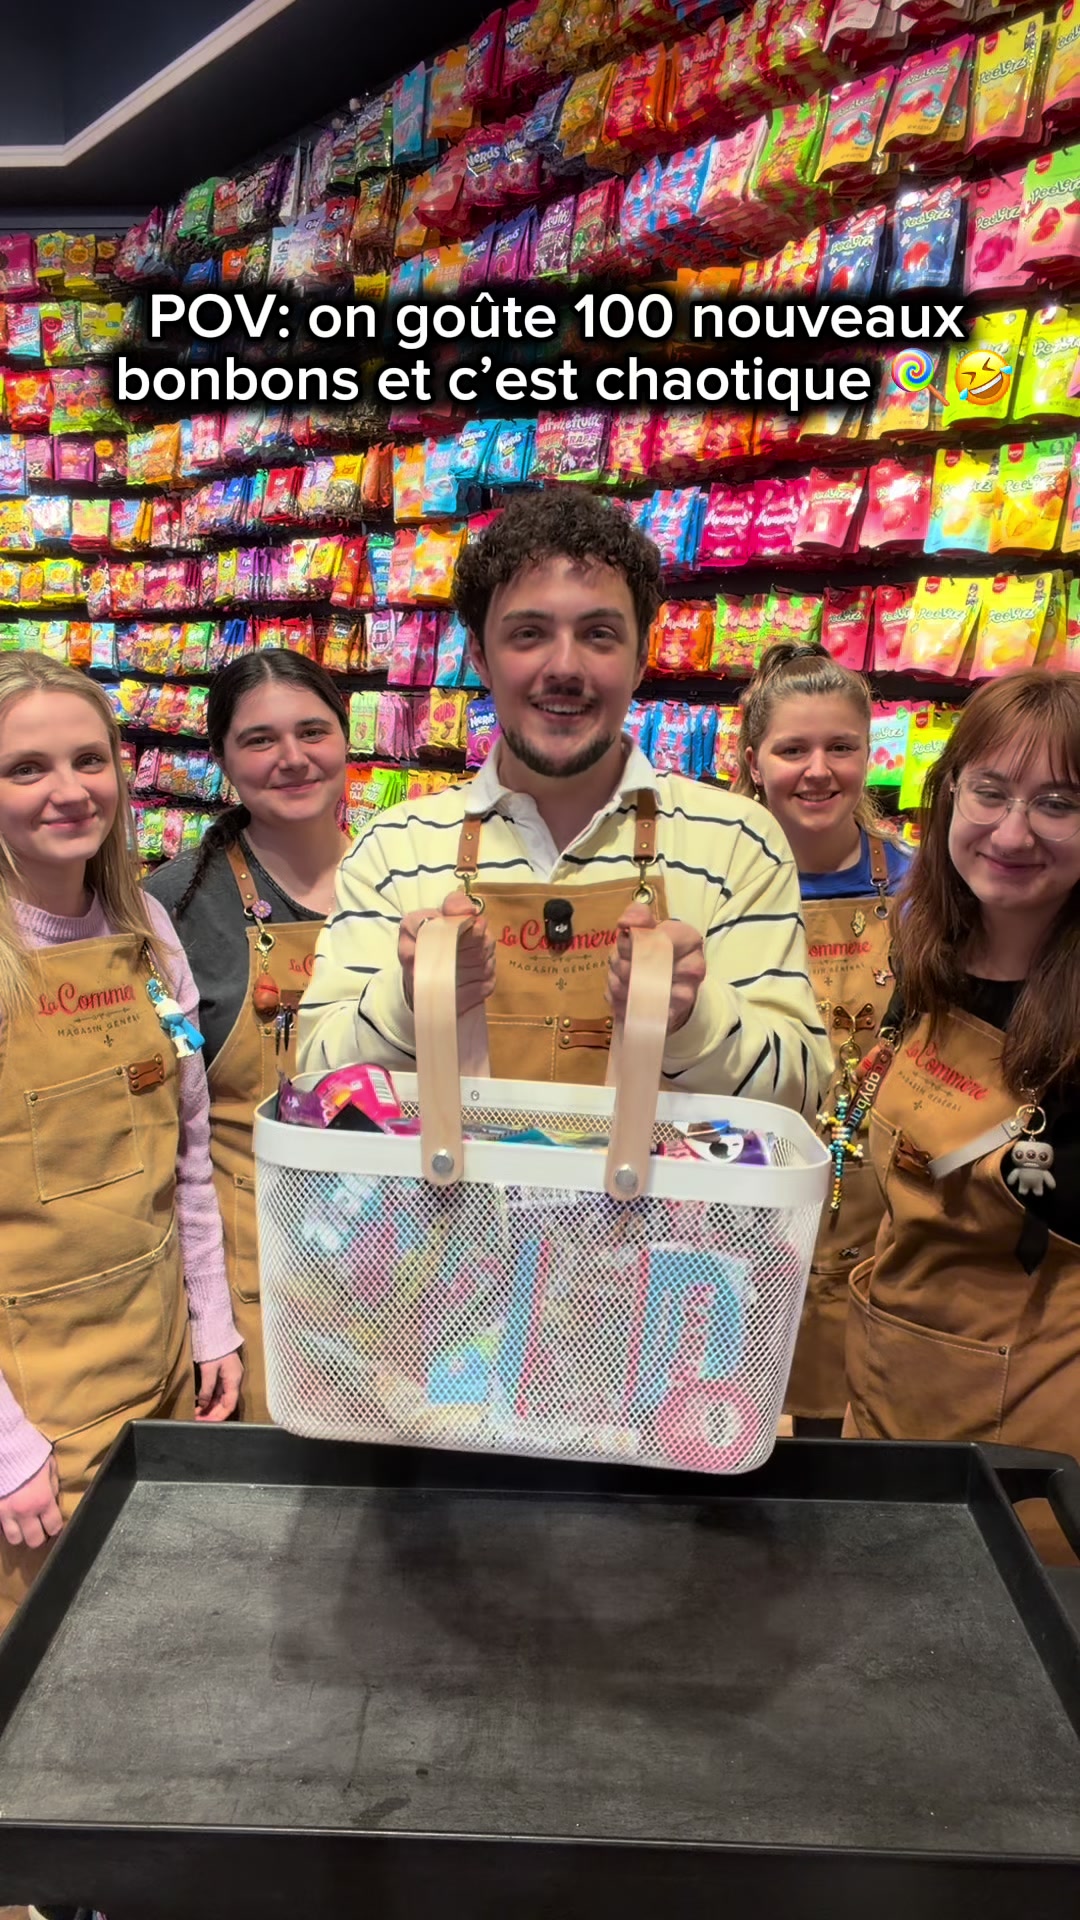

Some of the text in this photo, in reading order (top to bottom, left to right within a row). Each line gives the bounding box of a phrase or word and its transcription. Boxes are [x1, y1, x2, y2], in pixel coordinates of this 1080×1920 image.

[499, 918, 619, 951] La Comère
[509, 959, 559, 974] MAGASIN
[39, 993, 58, 1015] La
[57, 1025, 103, 1037] MAGASIN
